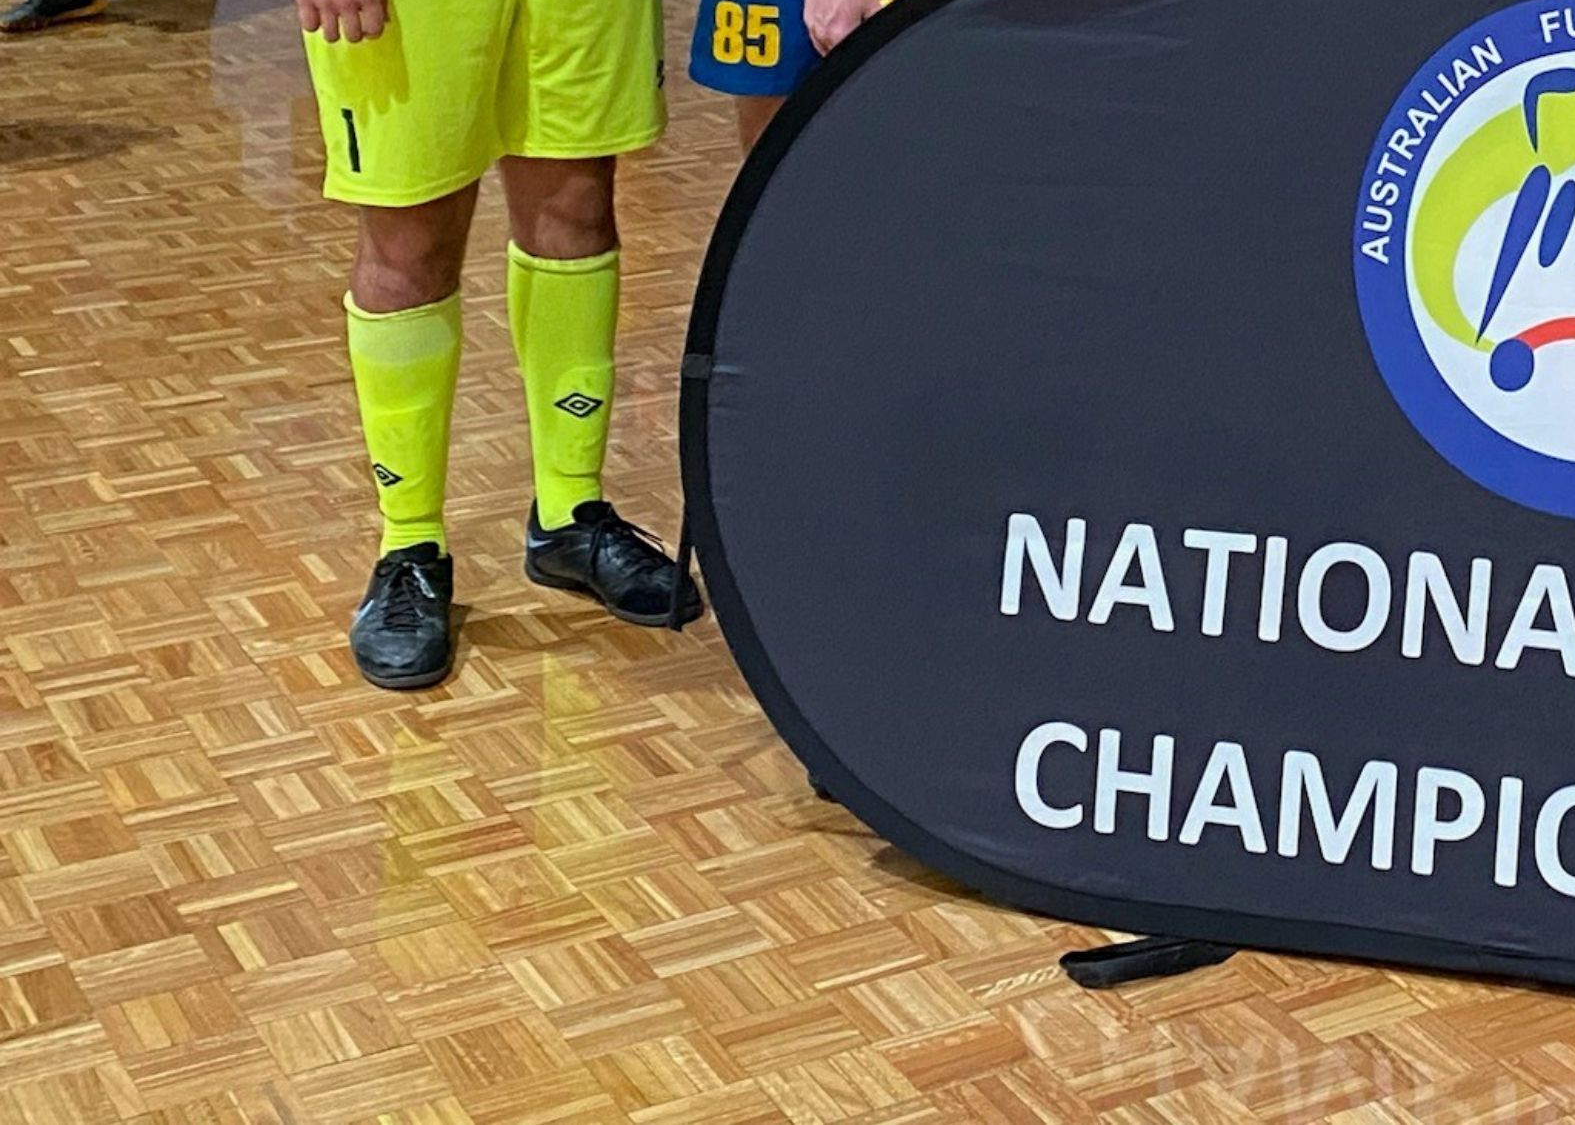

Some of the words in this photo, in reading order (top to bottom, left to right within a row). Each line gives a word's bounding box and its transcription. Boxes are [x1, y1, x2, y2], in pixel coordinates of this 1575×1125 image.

[712, 0, 781, 67] 85
[340, 107, 361, 173] 1
[1361, 36, 1504, 264] AUSTRALIAN
